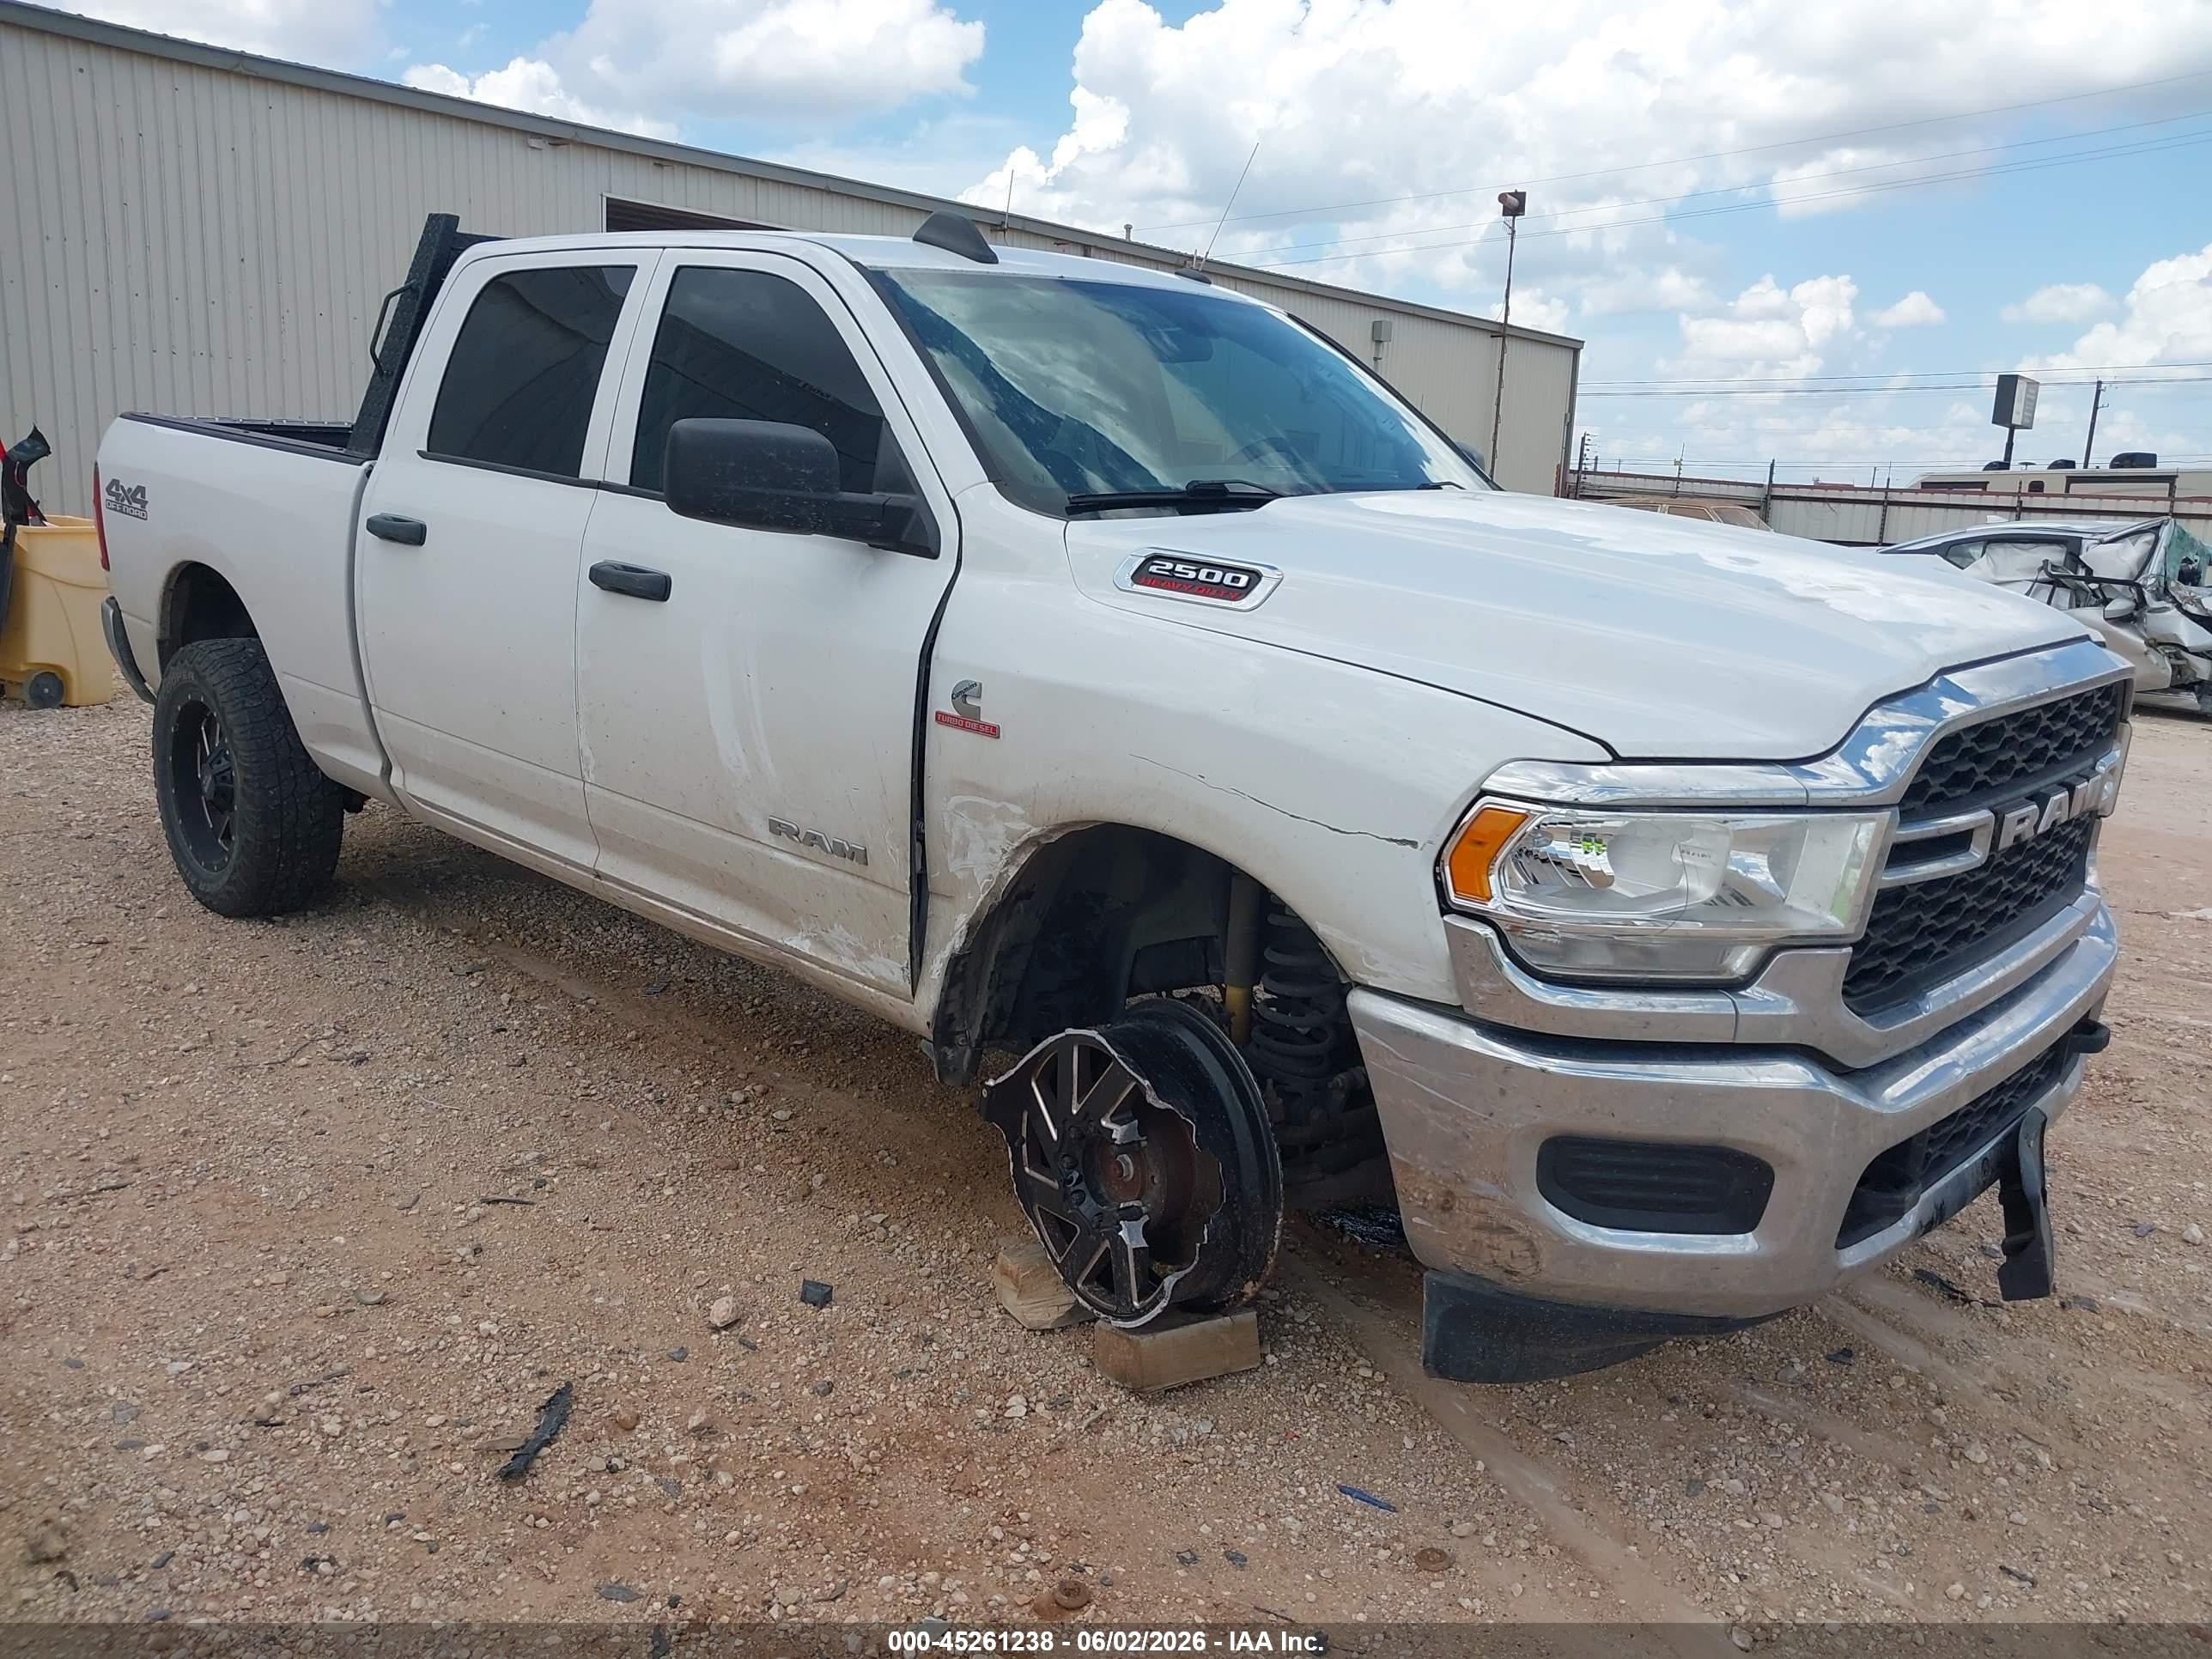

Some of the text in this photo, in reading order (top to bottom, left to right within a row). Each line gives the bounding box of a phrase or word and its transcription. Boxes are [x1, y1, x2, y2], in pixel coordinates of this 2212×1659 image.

[106, 478, 149, 509] 4x4
[1148, 560, 1249, 587] 2500
[1139, 576, 1243, 600] HEAVY DUTY
[951, 682, 977, 700] Cummins
[938, 714, 997, 736] TURBO DIESEL
[1998, 771, 2103, 850] RAM
[769, 815, 869, 866] RAM
